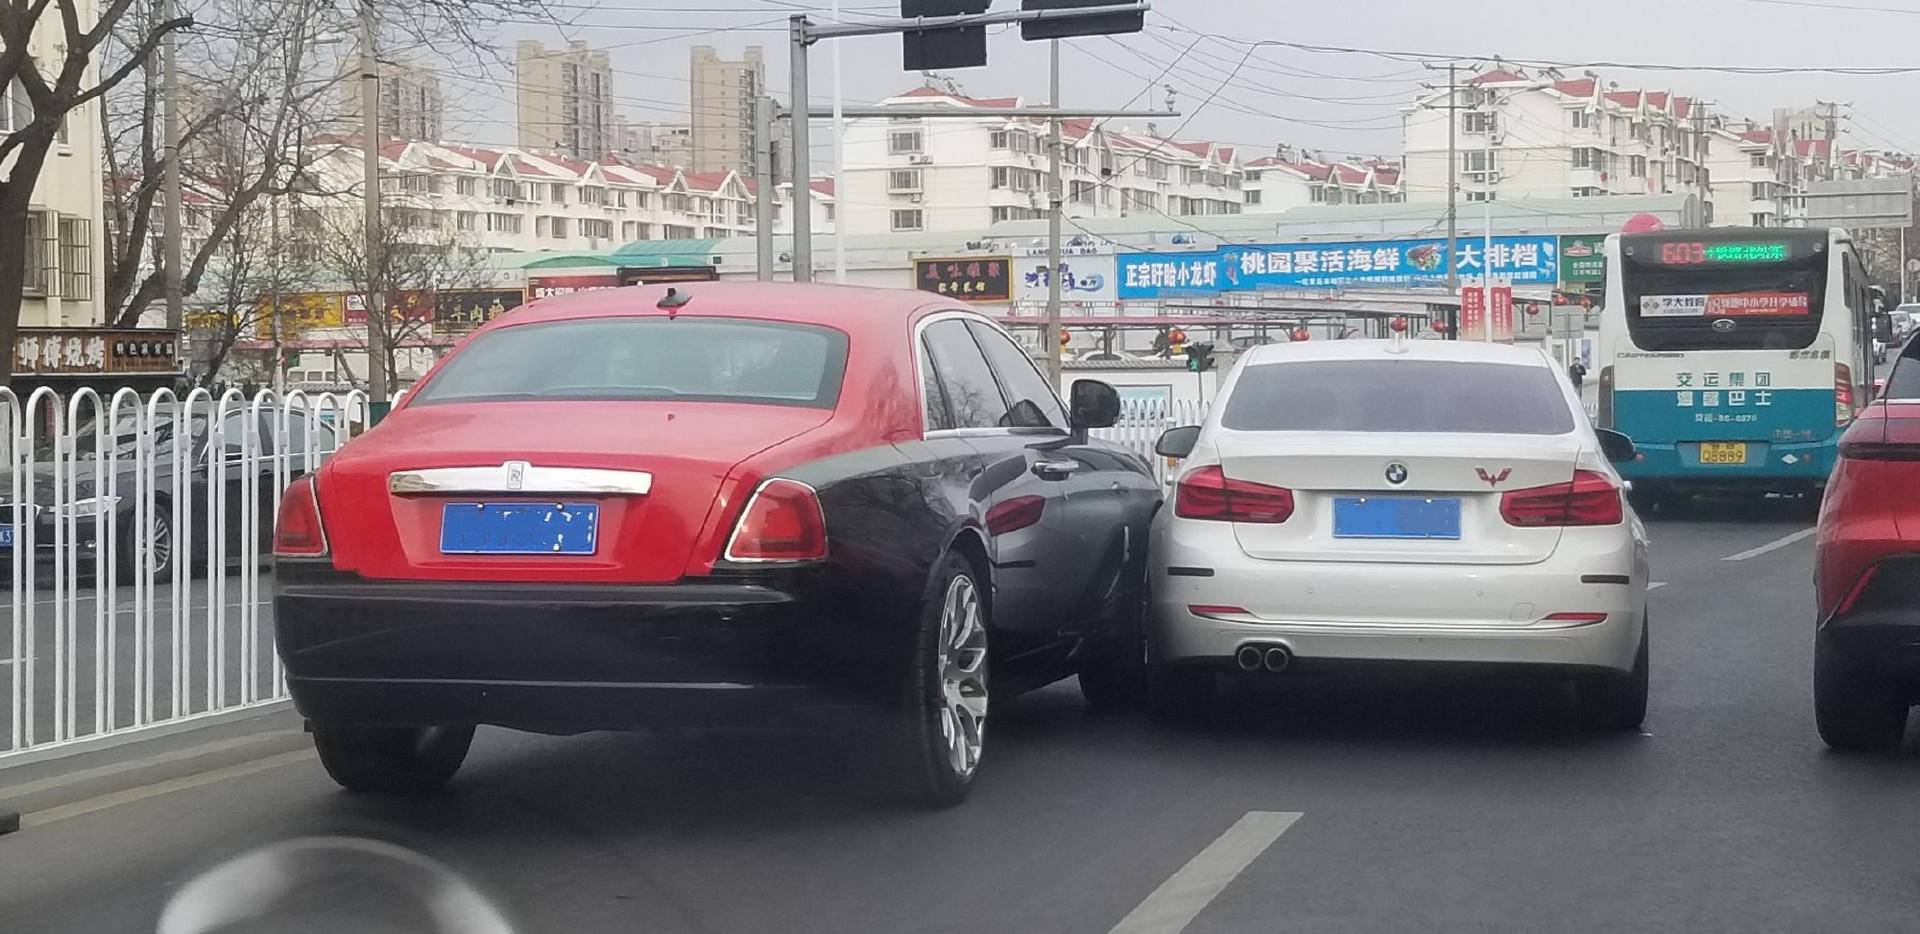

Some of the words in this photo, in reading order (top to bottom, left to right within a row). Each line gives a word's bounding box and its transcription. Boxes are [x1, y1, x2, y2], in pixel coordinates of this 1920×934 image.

[1240, 248, 1400, 275] 桃园聚活海鲜
[1455, 244, 1538, 268] 大排档
[1662, 243, 1703, 264] 603
[18, 335, 105, 370] 师傅烧烤
[1677, 372, 1771, 387] 交运集团
